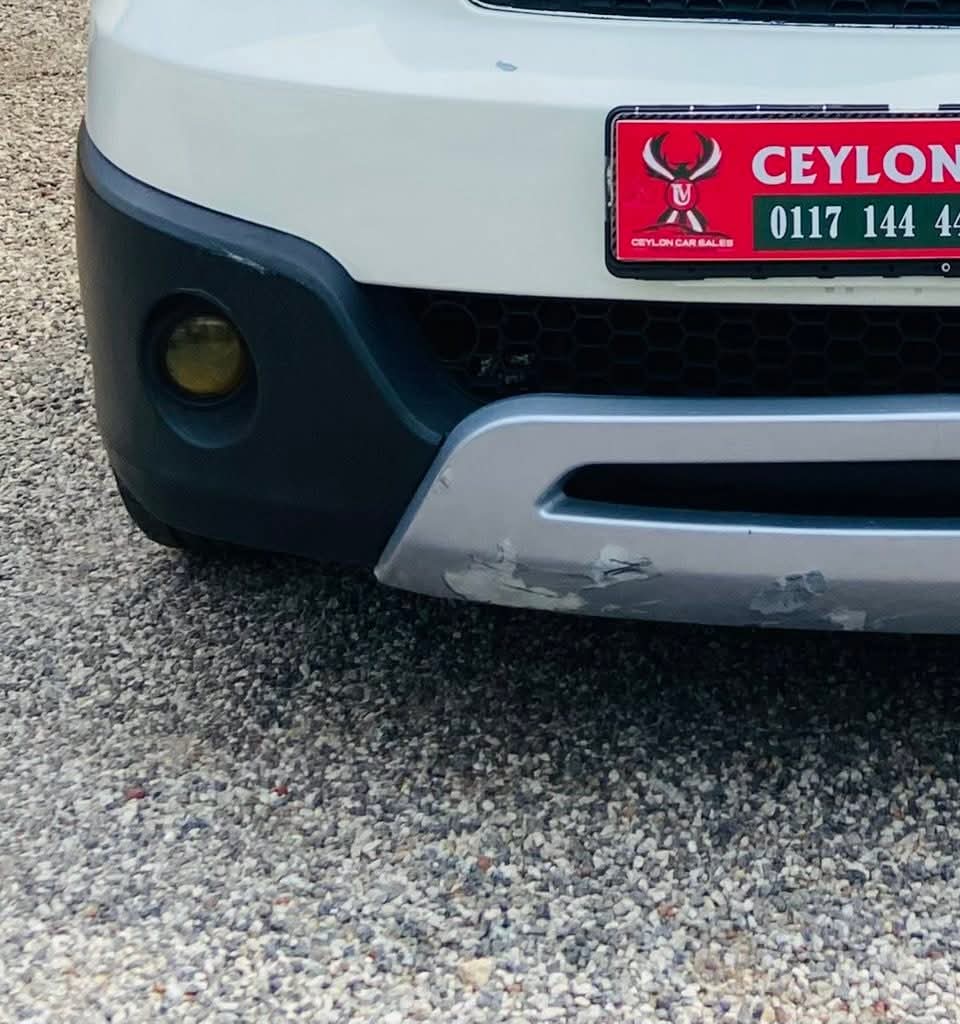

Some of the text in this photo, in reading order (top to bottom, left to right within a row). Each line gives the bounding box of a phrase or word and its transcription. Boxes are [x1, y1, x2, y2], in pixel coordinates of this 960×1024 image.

[770, 205, 842, 239] 0117
[863, 204, 916, 238] 144
[631, 238, 734, 247] CEYLON CAR SALES
